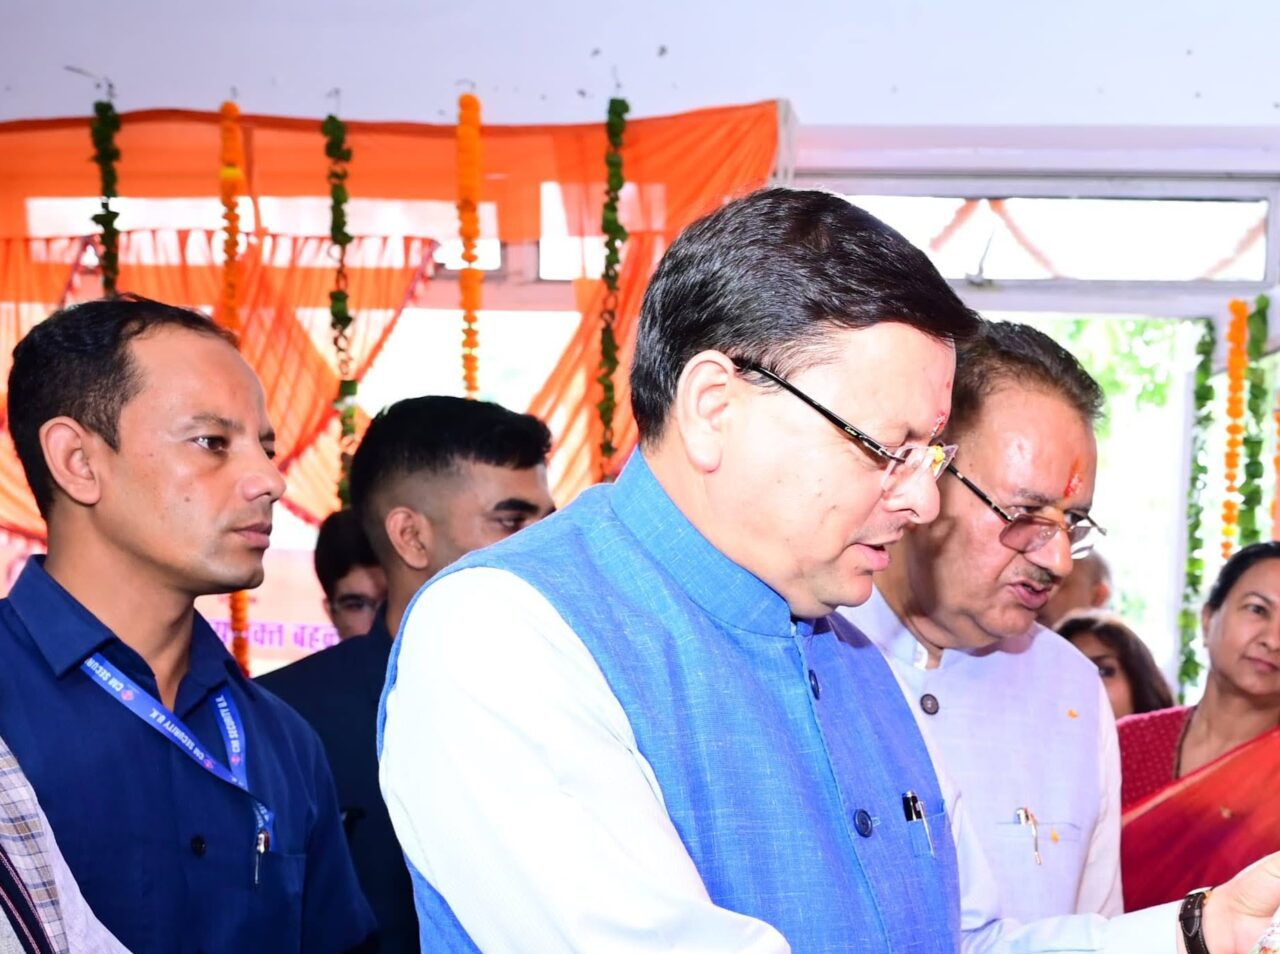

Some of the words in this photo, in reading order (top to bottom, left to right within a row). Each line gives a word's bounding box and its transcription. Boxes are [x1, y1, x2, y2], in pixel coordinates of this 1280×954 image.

[85, 657, 111, 682] SECUR
[163, 719, 196, 750] SECURITY
[193, 747, 205, 760] CM
